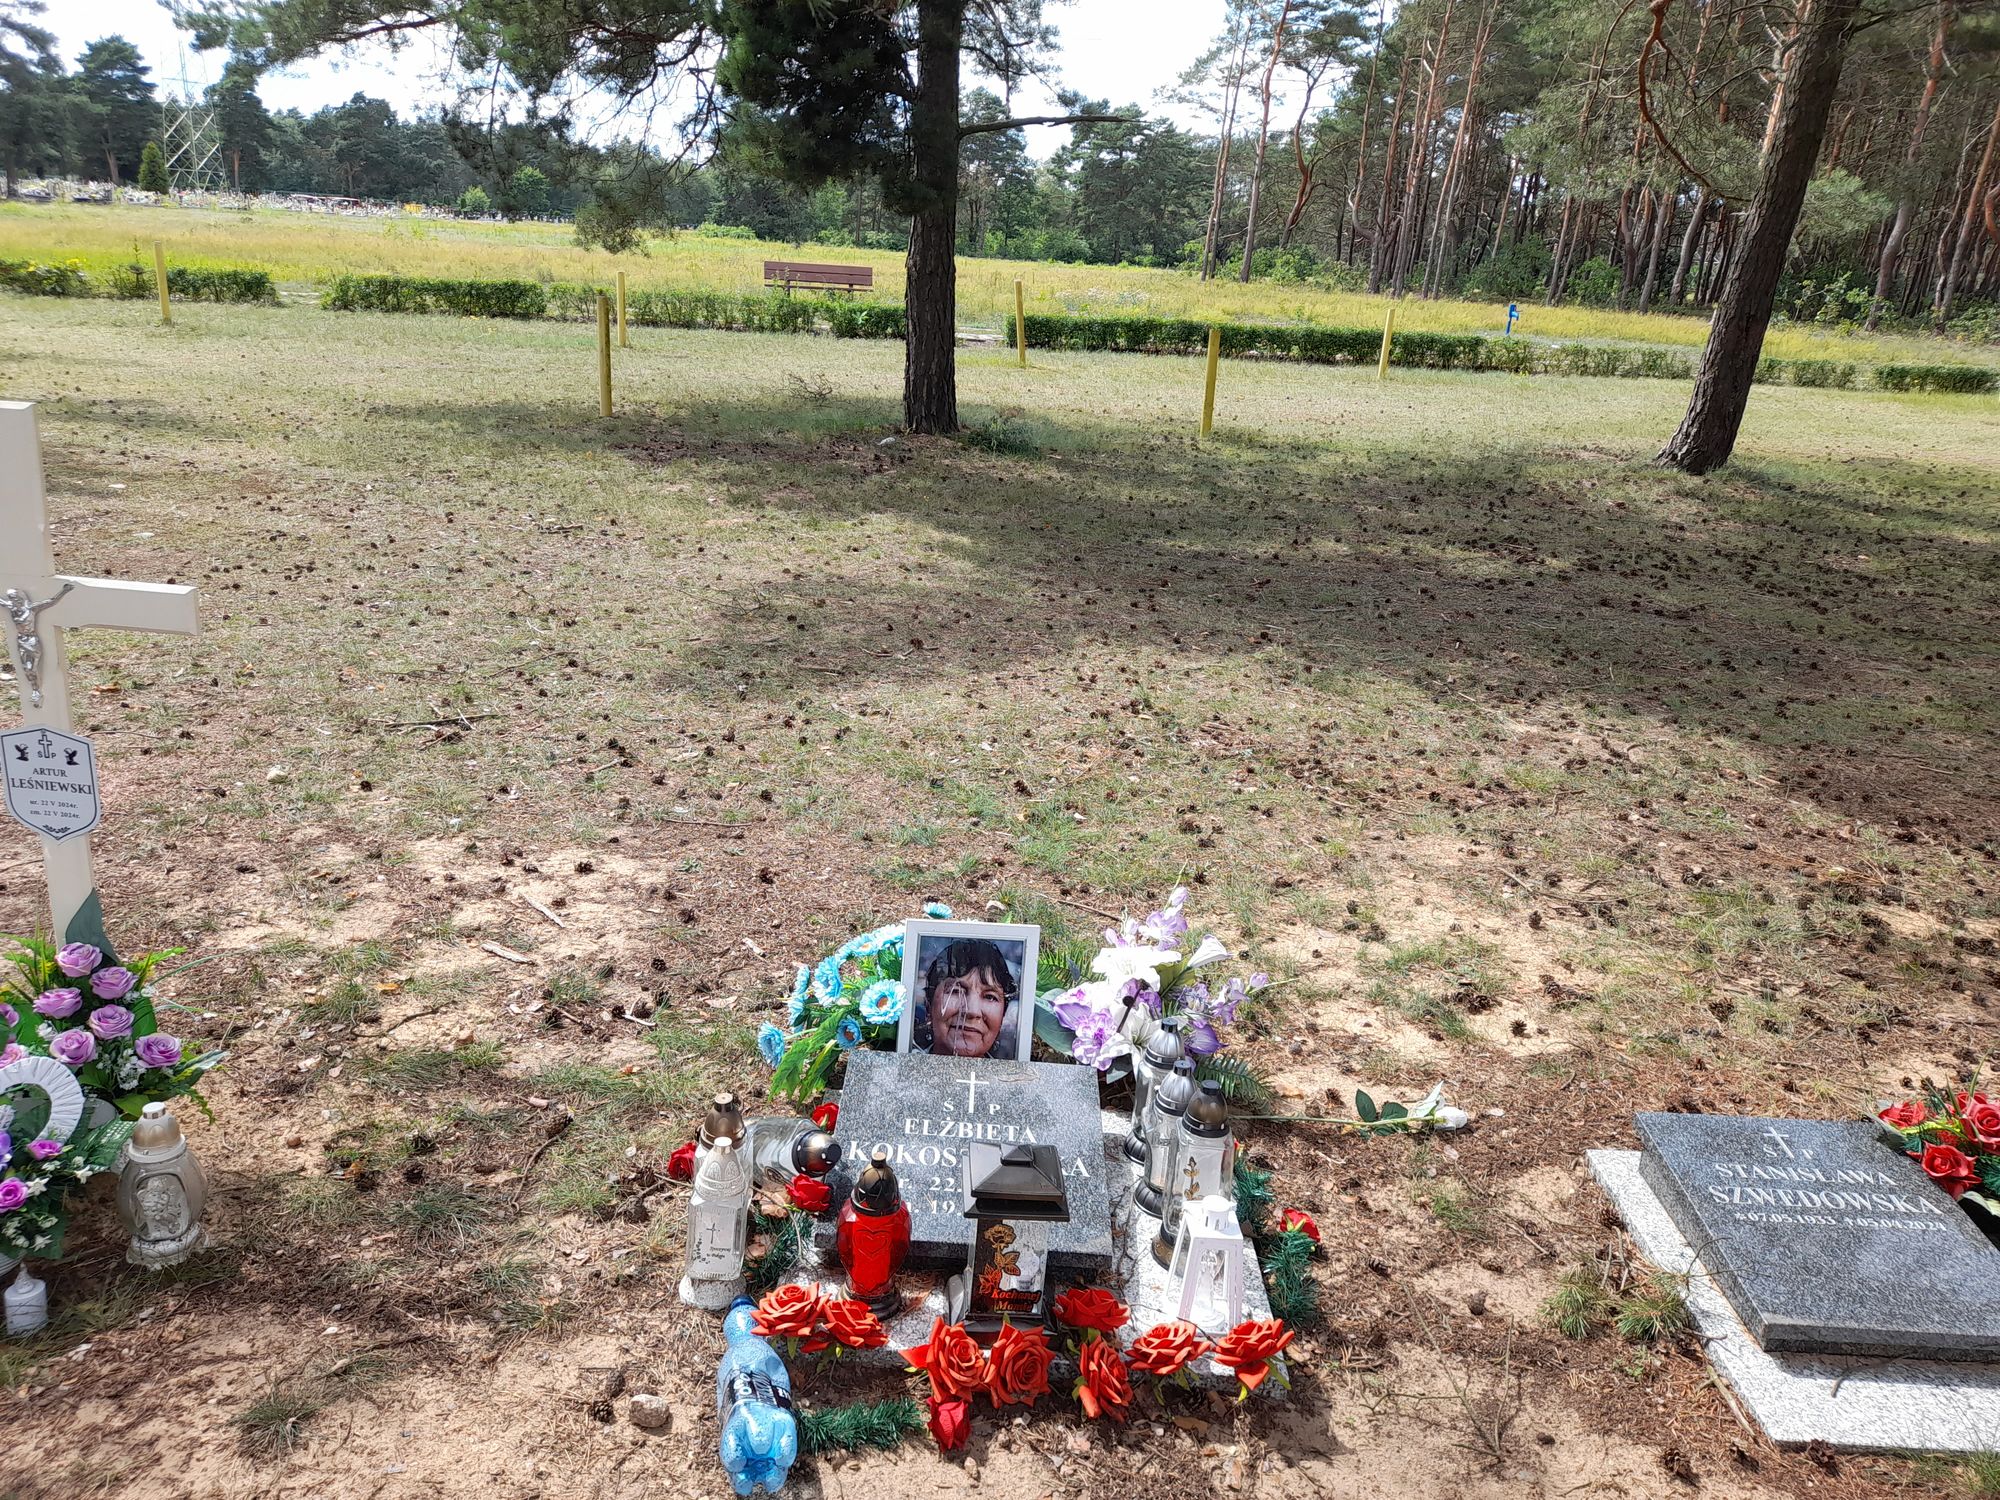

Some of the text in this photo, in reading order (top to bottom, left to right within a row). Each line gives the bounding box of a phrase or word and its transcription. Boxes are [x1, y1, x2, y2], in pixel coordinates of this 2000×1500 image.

[32, 767, 68, 778] ARTUR
[11, 777, 92, 795] LEŚNIEWSKI
[989, 1103, 1001, 1115] P
[904, 1117, 1037, 1144] ELŻBIETA
